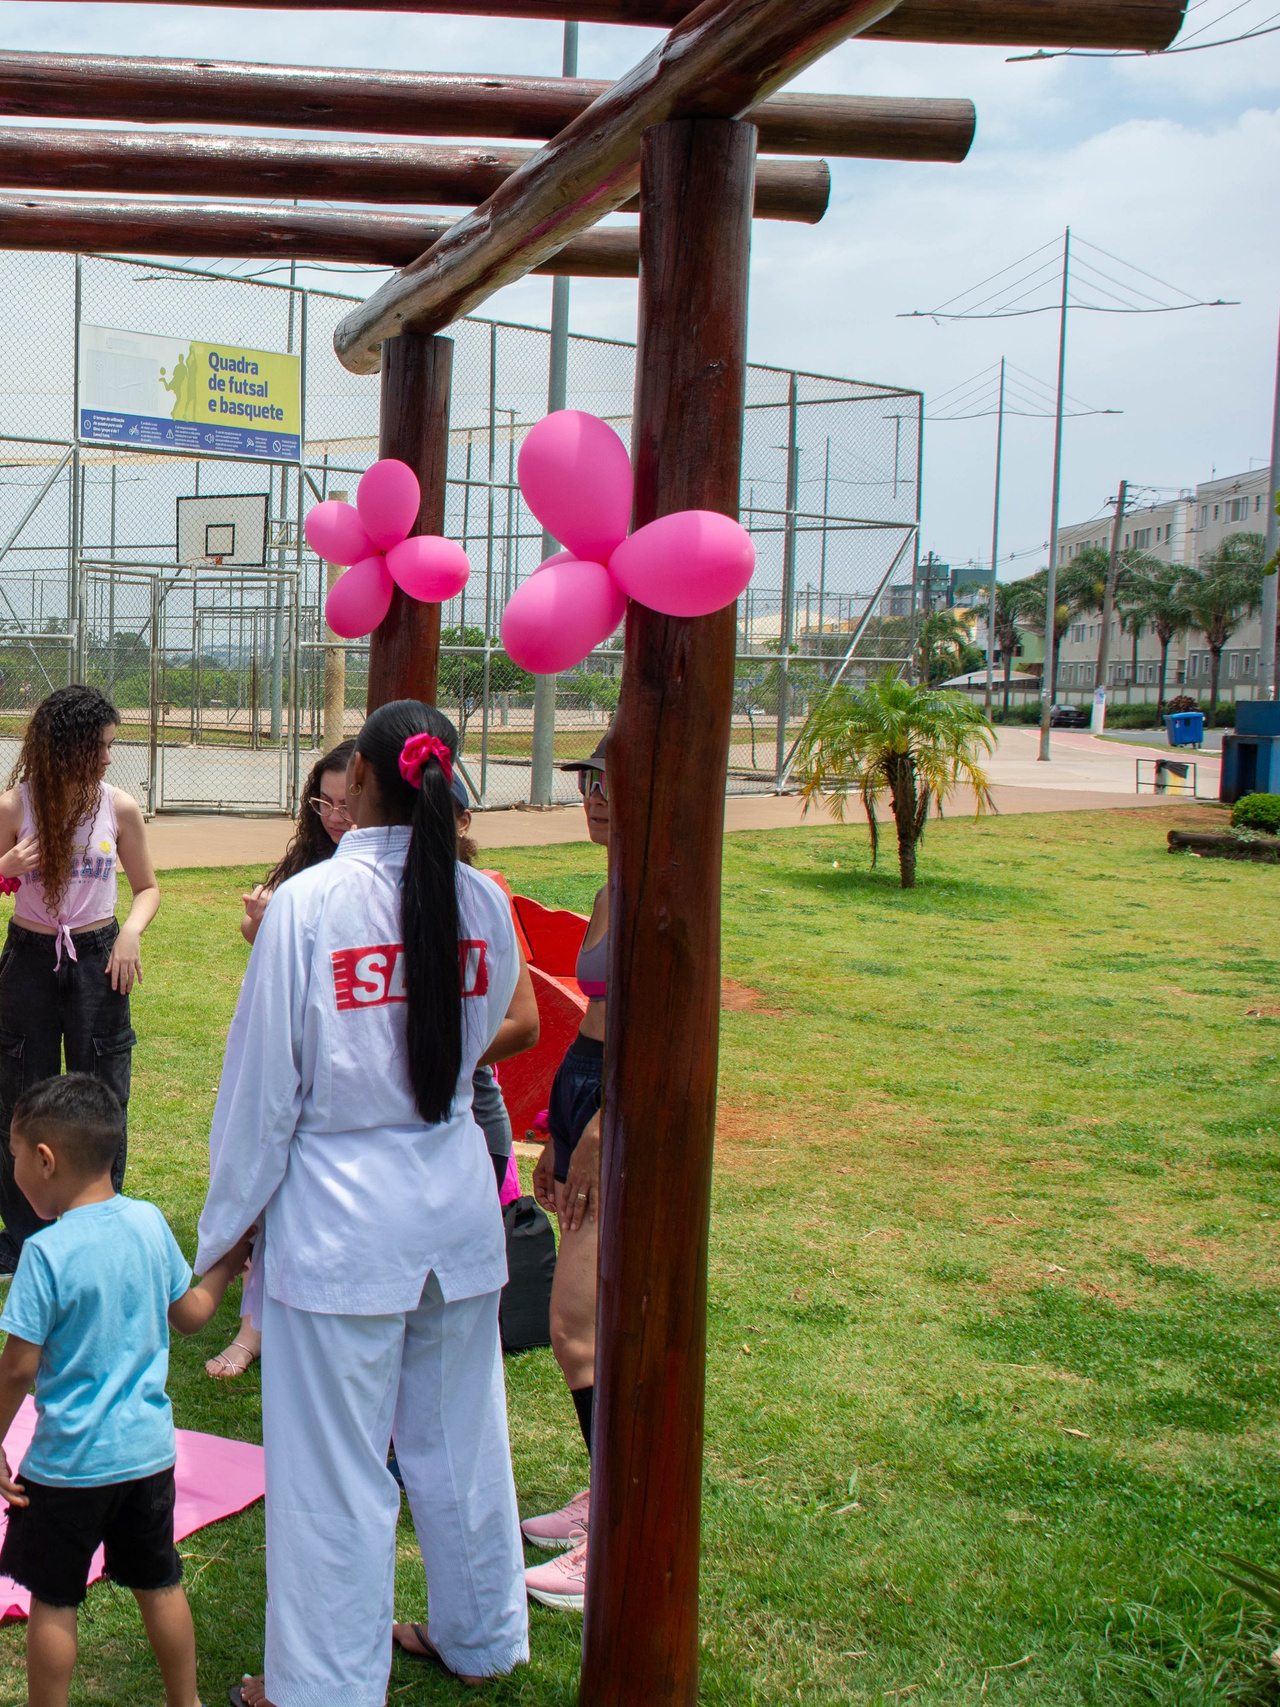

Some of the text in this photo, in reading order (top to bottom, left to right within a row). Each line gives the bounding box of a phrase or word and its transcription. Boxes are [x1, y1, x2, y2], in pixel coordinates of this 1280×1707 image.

[208, 352, 258, 375] Quadra
[208, 373, 268, 398] de futsal
[208, 396, 283, 421] e basquete
